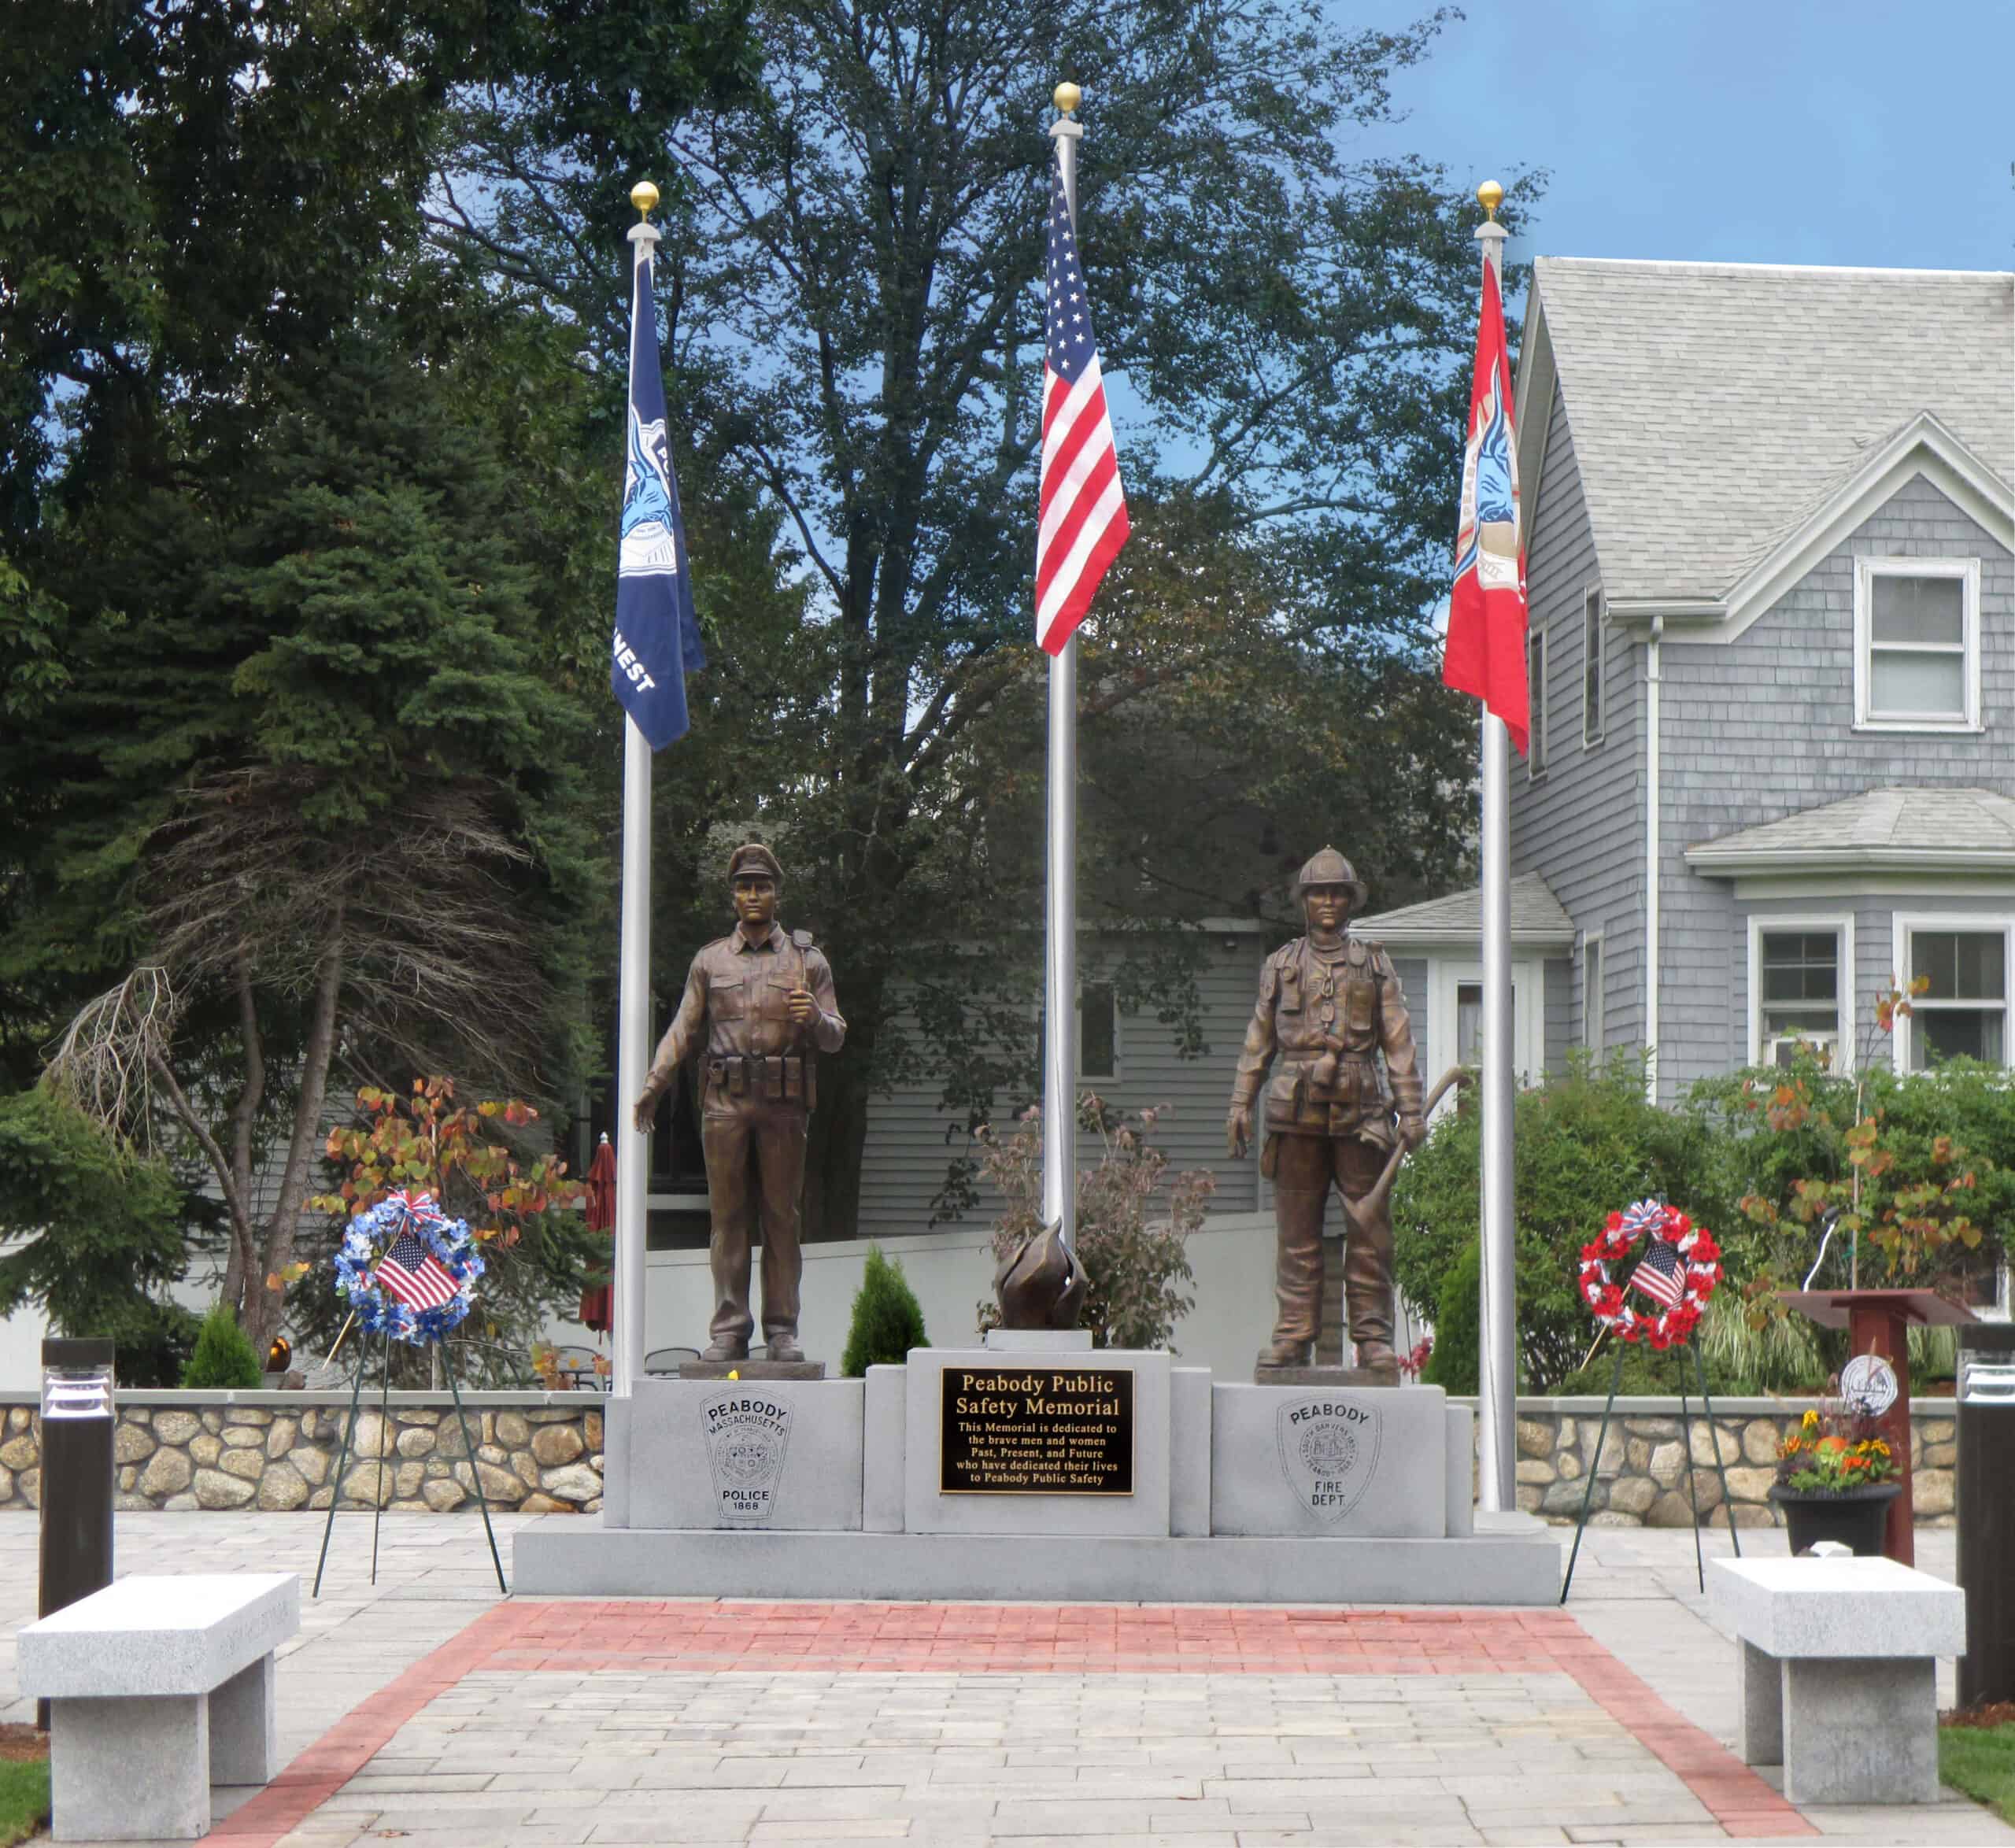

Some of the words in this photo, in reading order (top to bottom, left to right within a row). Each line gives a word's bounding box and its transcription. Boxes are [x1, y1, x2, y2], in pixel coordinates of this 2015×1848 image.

[613, 627, 655, 692] NEST
[962, 1374, 1044, 1396] Peabody
[1051, 1375, 1114, 1392] Public
[708, 1400, 787, 1421] PEABODY
[956, 1398, 1018, 1418] Safety
[1026, 1399, 1120, 1416] Memorial
[1290, 1404, 1370, 1425] PEABODY
[708, 1414, 785, 1436] MASSACHUSETTS
[958, 1421, 982, 1432] This
[985, 1422, 1036, 1432] Memorial
[1040, 1423, 1048, 1432] is
[1052, 1423, 1103, 1433] dedicated
[1106, 1425, 1117, 1433] to
[968, 1435, 985, 1444] the
[988, 1435, 1018, 1445] brave
[1046, 1436, 1065, 1445] and
[971, 1447, 996, 1458] Past,
[1000, 1448, 1043, 1458] Present,
[1046, 1448, 1065, 1458] and
[1069, 1448, 1104, 1458] Future
[956, 1460, 978, 1469] who
[982, 1460, 1007, 1469] have
[1010, 1460, 1060, 1470] dedicated
[1064, 1461, 1089, 1470] their
[1093, 1461, 1118, 1471] lives
[971, 1473, 981, 1482] to
[985, 1473, 1029, 1485] Peabody
[1033, 1473, 1067, 1483] Public
[1070, 1473, 1104, 1486] Safety
[1315, 1481, 1342, 1493] FIRE
[723, 1491, 769, 1501] POLICE
[1312, 1495, 1345, 1506] DEPT.
[734, 1502, 759, 1510] 1868
